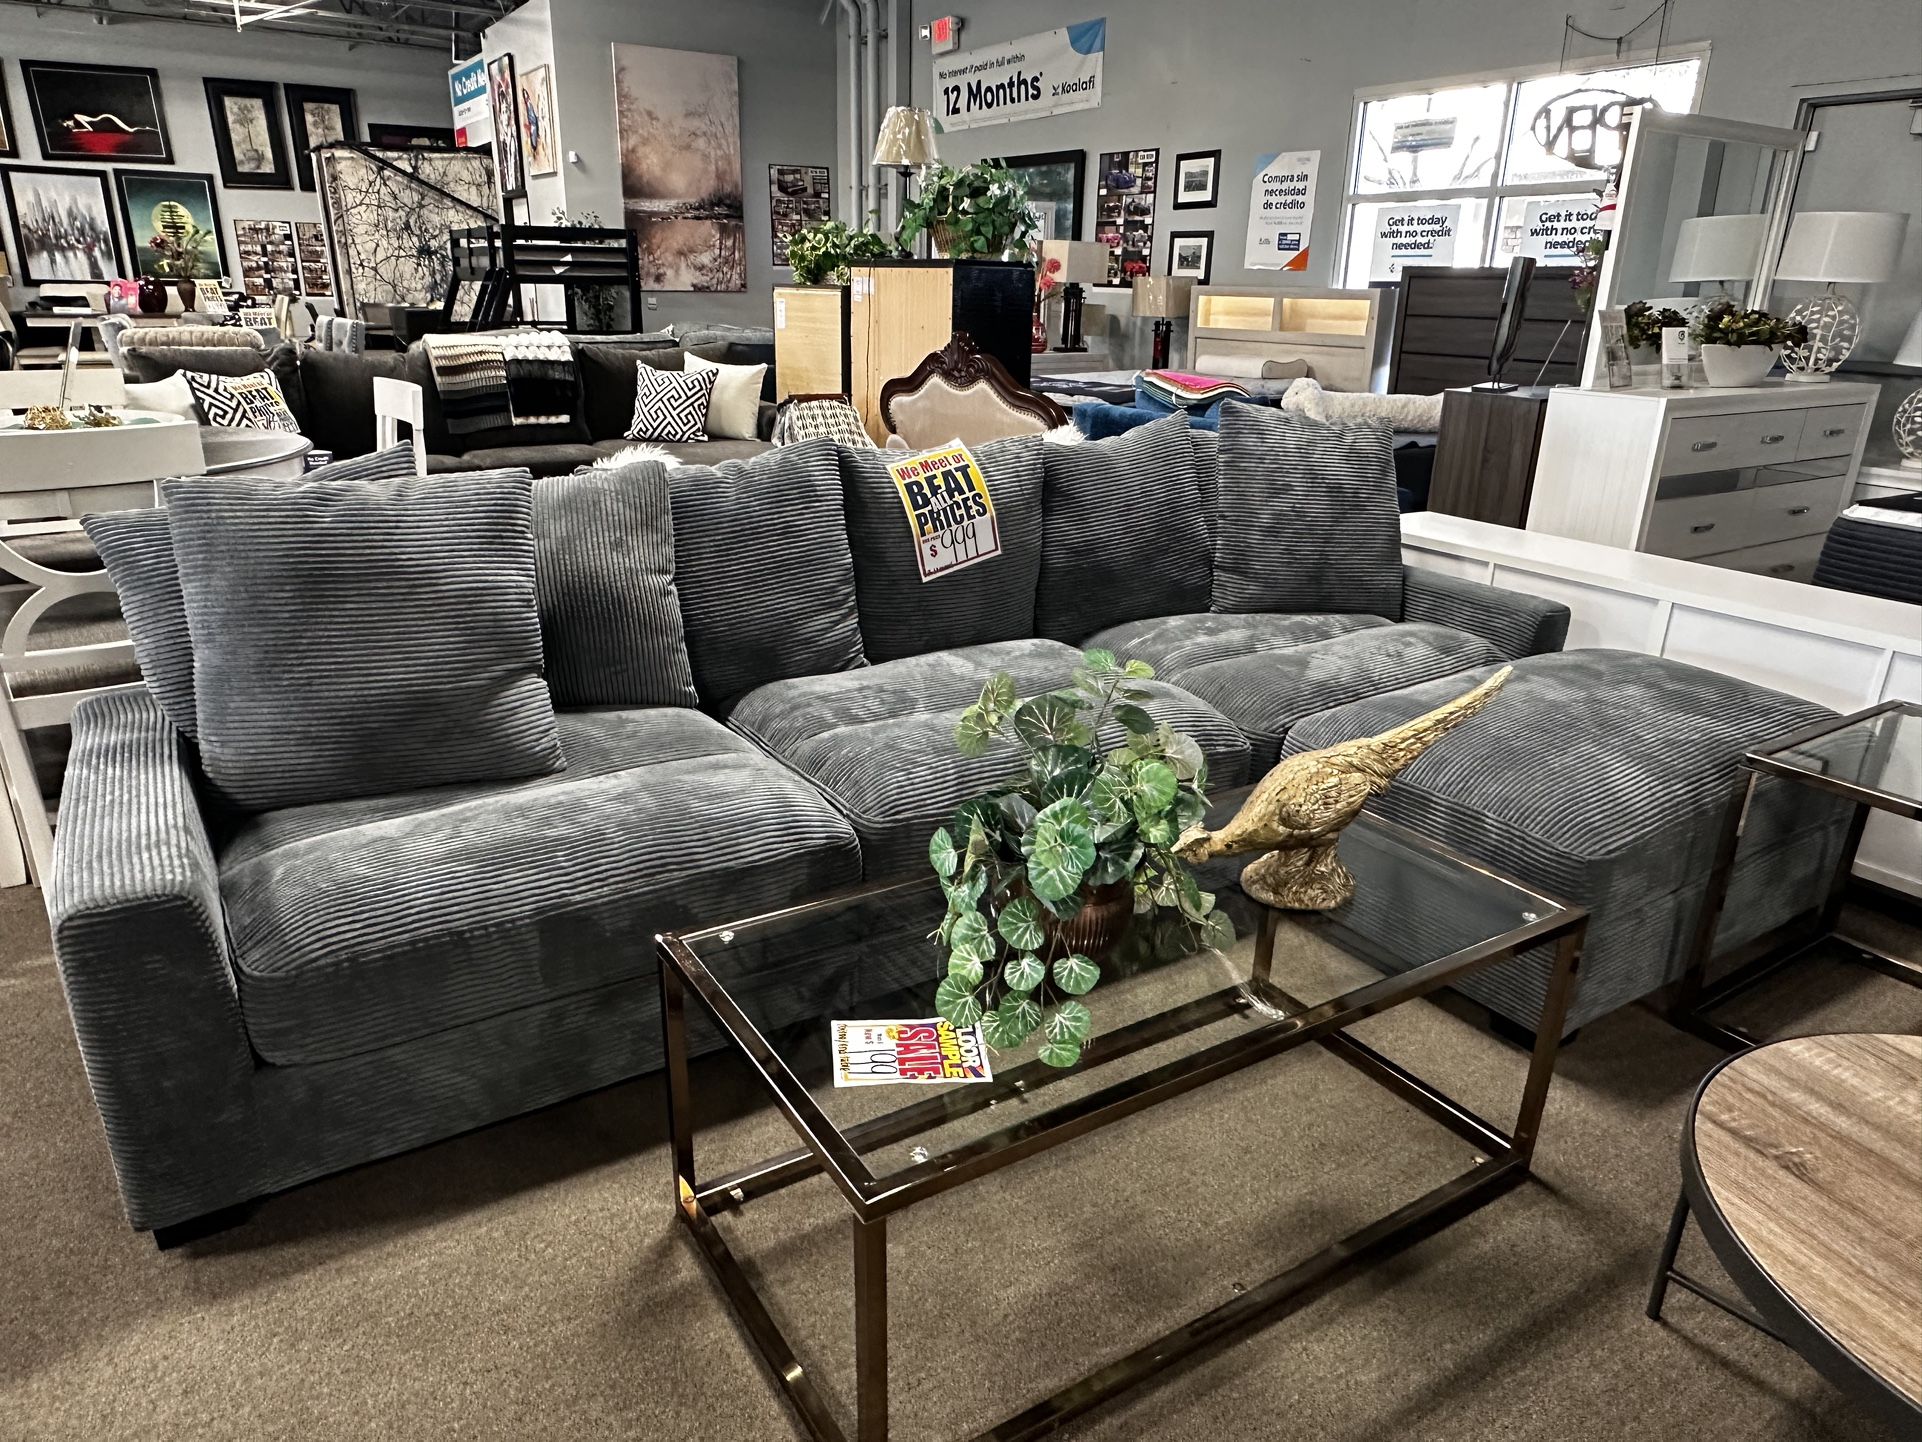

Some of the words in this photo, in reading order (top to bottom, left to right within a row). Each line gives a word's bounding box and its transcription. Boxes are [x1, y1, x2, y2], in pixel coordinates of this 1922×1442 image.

[939, 71, 947, 79] No
[948, 67, 968, 78] interest
[973, 60, 988, 75] paid
[988, 60, 994, 69] in
[996, 56, 1005, 67] full
[1007, 53, 1025, 65] within
[1061, 74, 1096, 95] Koalafi
[943, 84, 961, 116] 12
[1262, 174, 1294, 185] Compra
[1296, 172, 1308, 182] sin
[1264, 186, 1307, 197] necesidad
[1263, 200, 1273, 210] de
[1275, 199, 1305, 210] crédito
[1387, 217, 1405, 227] Get
[1407, 215, 1415, 227] it
[1416, 214, 1448, 227] today
[1539, 212, 1562, 223] Get
[1563, 210, 1574, 222] it
[1380, 227, 1402, 239] with
[1404, 230, 1418, 238] no
[1420, 225, 1453, 238] credit
[1530, 224, 1558, 237] with
[1560, 226, 1577, 236] no
[244, 317, 273, 326] BEAT
[238, 387, 275, 405] BEAT
[896, 466, 920, 480] We
[919, 455, 952, 474] Meet
[951, 453, 966, 464] or
[904, 464, 976, 511] BEAT
[930, 490, 954, 512] ALL
[915, 492, 988, 537] PRICES
[930, 544, 938, 558] $
[941, 521, 980, 563] 999
[895, 1026, 943, 1077] SALE
[937, 1021, 964, 1078] SAMPLE
[956, 1025, 982, 1067] LOOR
